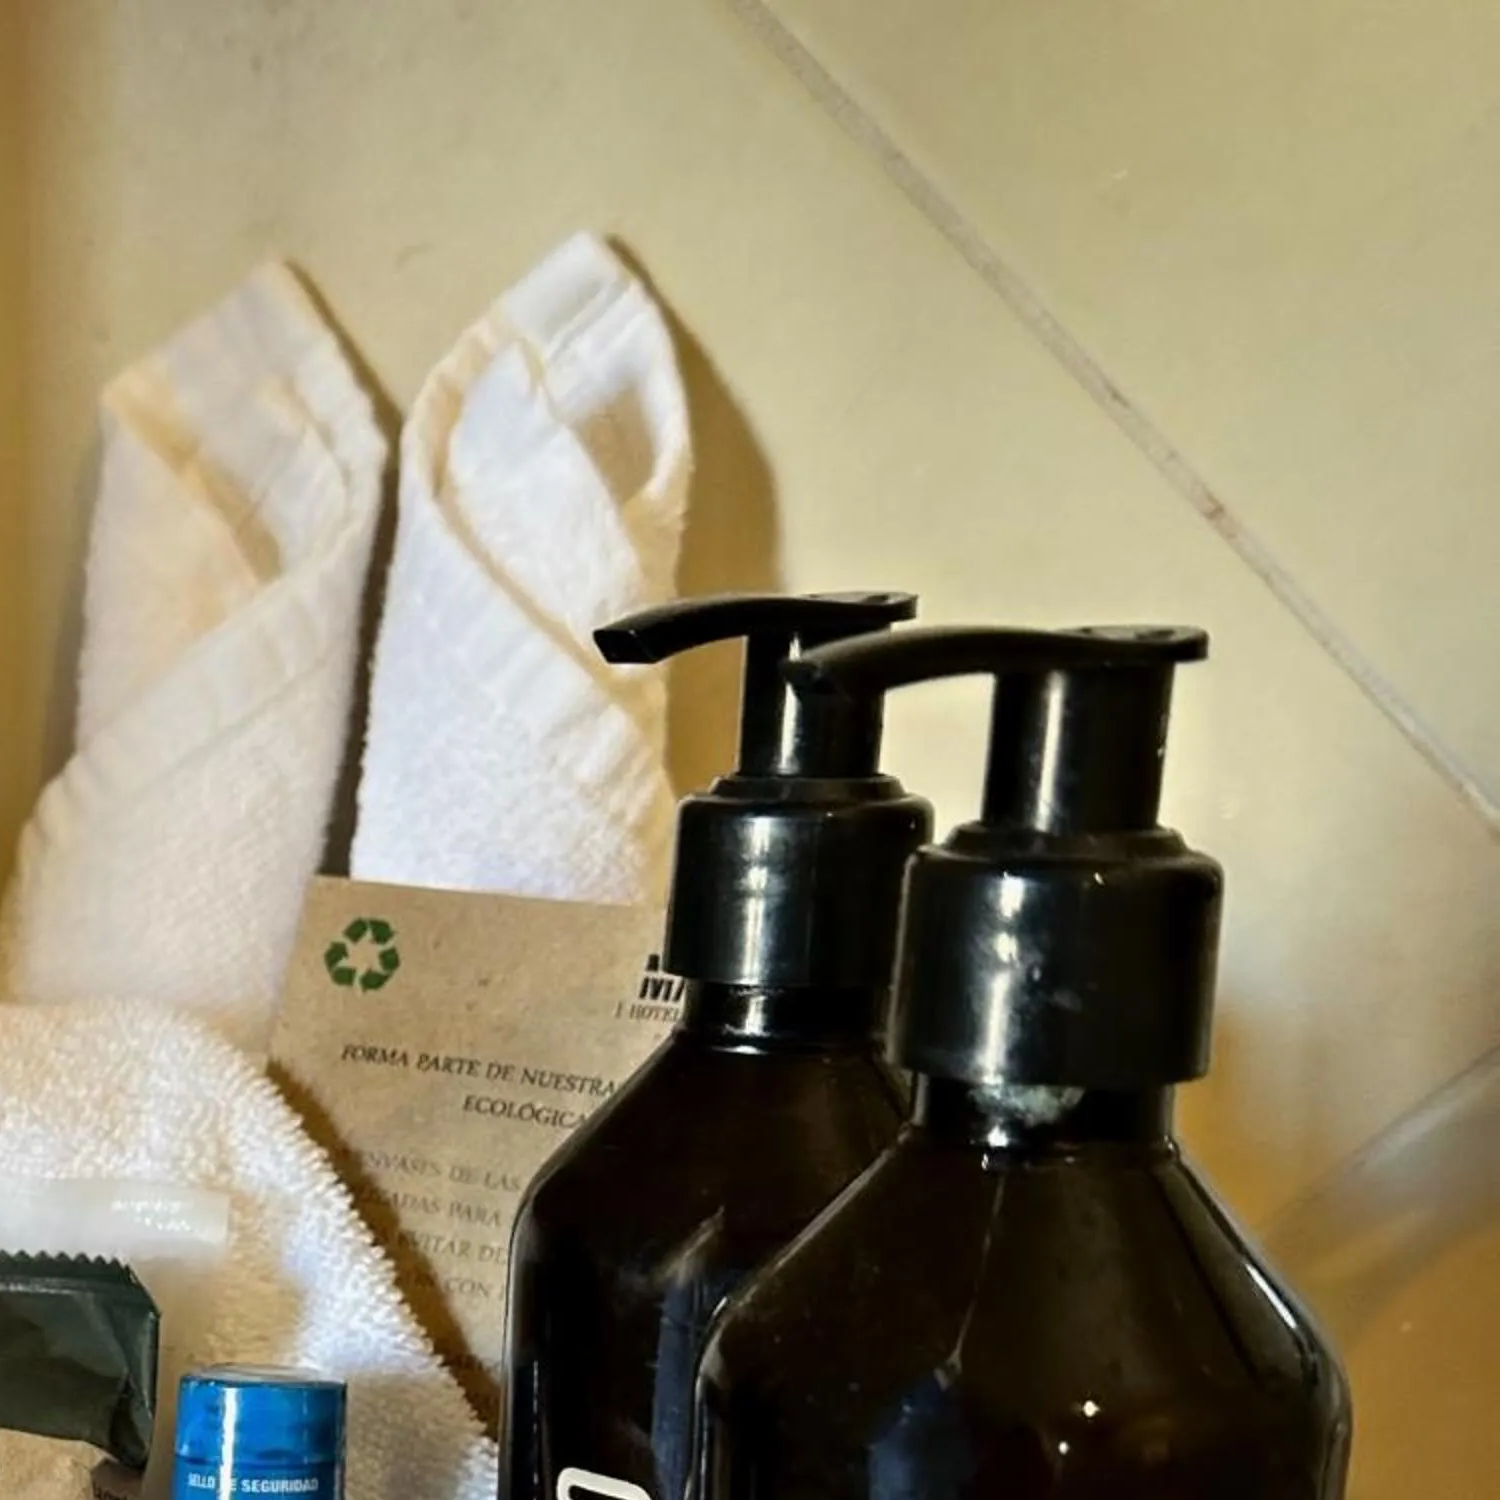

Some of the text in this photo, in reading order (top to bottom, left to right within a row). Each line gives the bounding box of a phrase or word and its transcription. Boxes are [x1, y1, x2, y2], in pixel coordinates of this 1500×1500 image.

[341, 1044, 618, 1097] FORMA PARTE DE NUESTRA
[484, 1172, 521, 1191] LAS
[450, 1202, 501, 1226] PARA
[241, 1477, 319, 1493] SEGURIDAD
